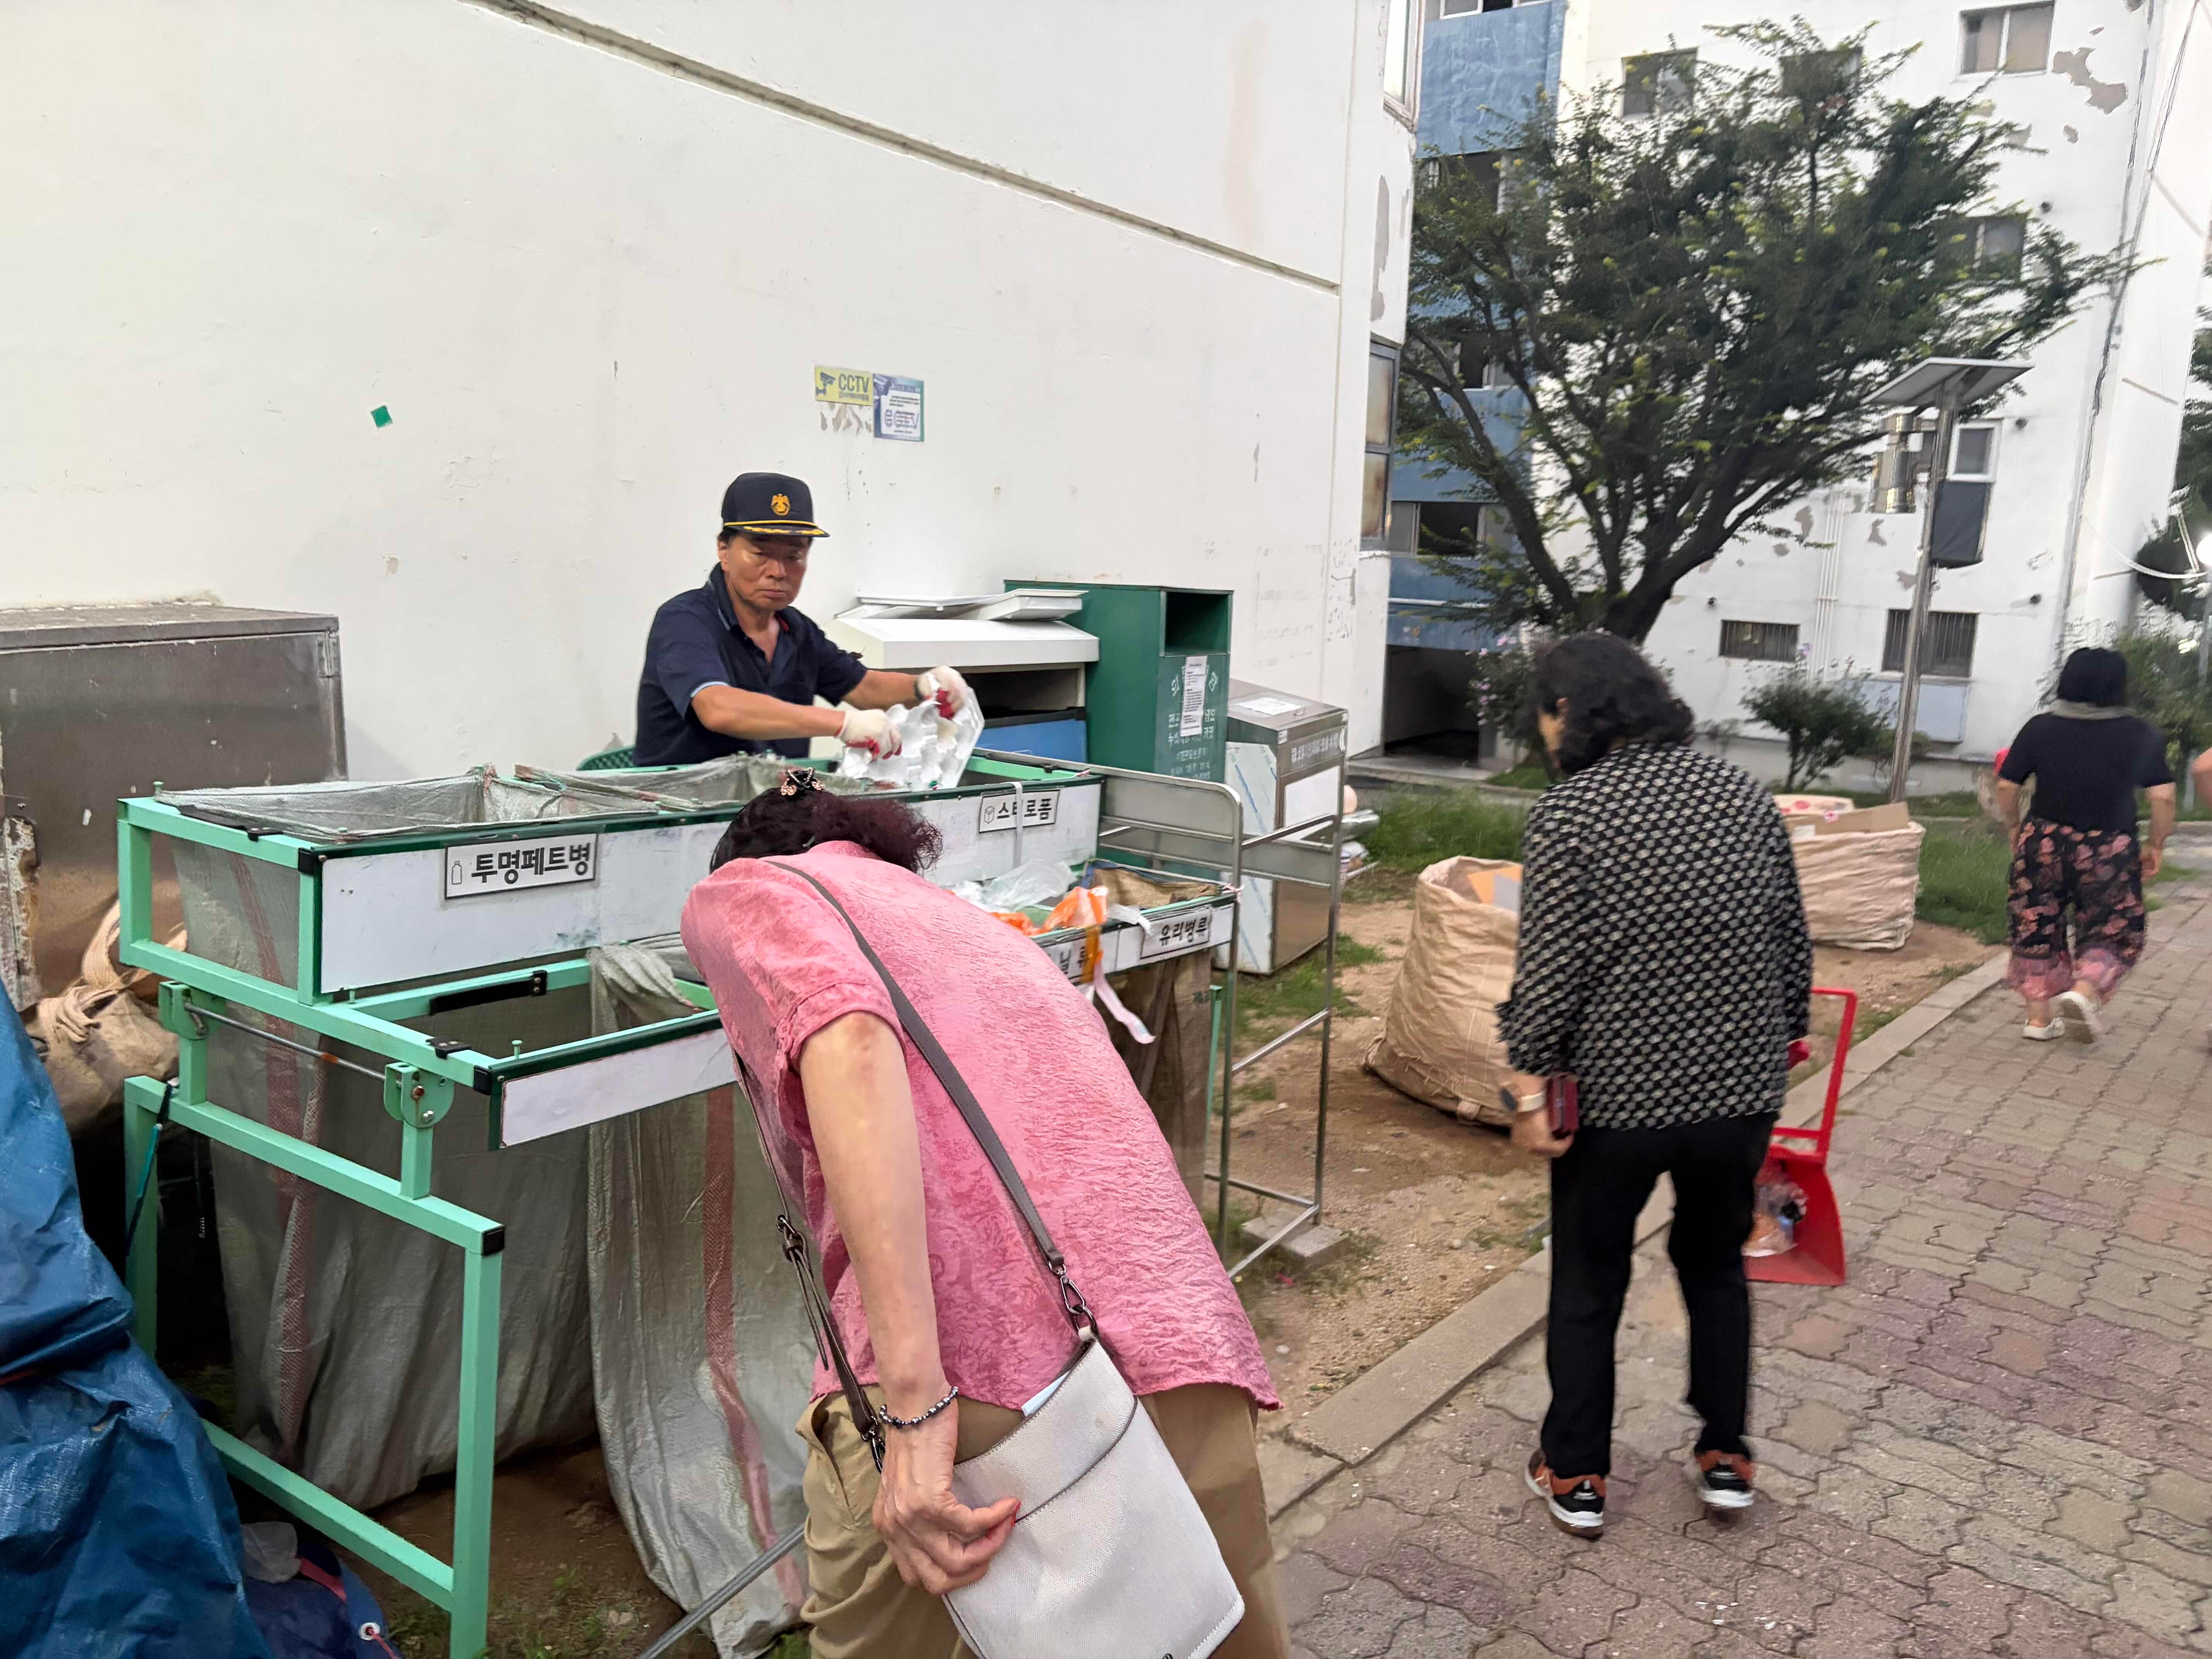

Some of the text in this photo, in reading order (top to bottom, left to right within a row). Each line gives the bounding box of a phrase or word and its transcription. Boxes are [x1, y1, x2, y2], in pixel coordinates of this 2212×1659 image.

[838, 373, 869, 392] CCTV
[471, 843, 591, 884] 투명페트병
[1159, 917, 1207, 946] 유리병류
